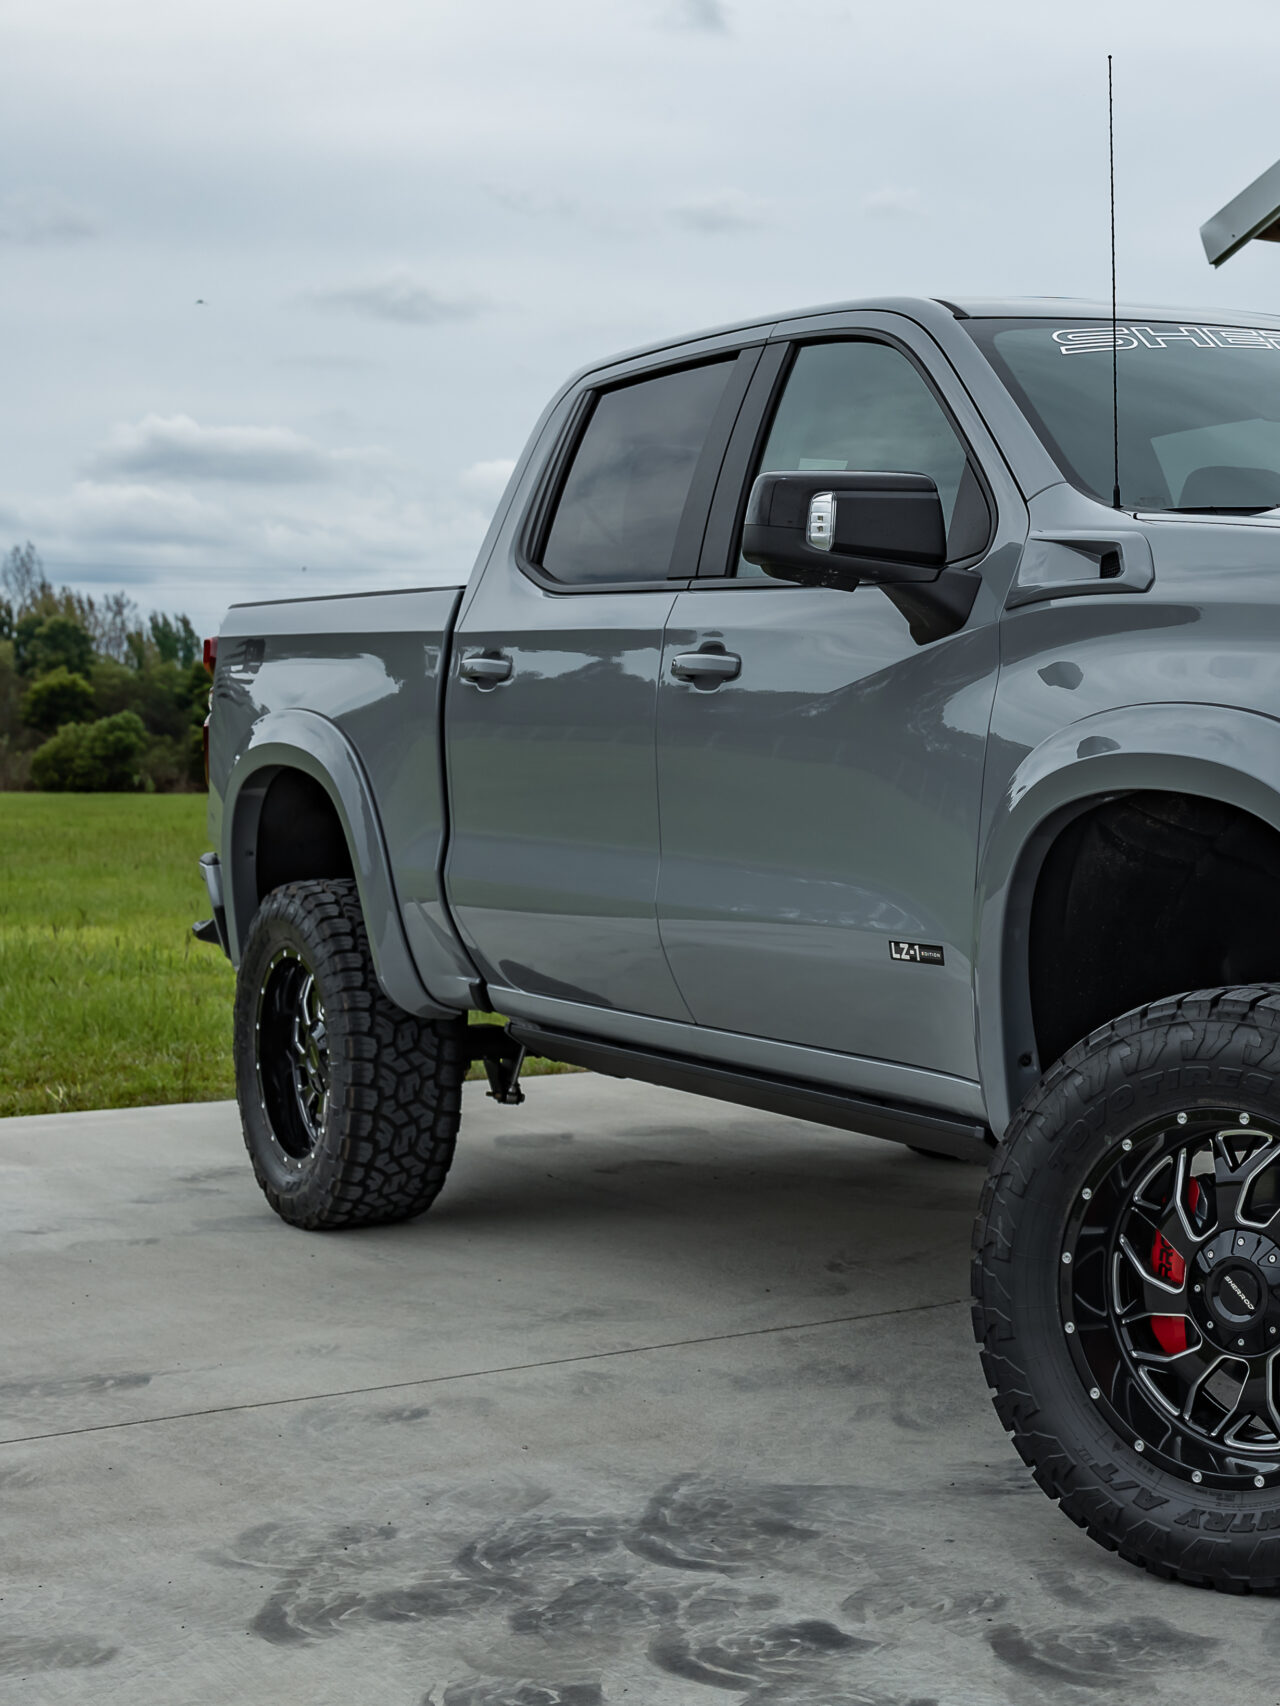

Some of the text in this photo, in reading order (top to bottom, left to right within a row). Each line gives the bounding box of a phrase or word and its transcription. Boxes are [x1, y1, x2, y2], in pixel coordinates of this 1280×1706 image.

[890, 941, 920, 961] LZ-1
[1140, 1065, 1274, 1096] TIRES
[1223, 1275, 1255, 1310] SHERROD
